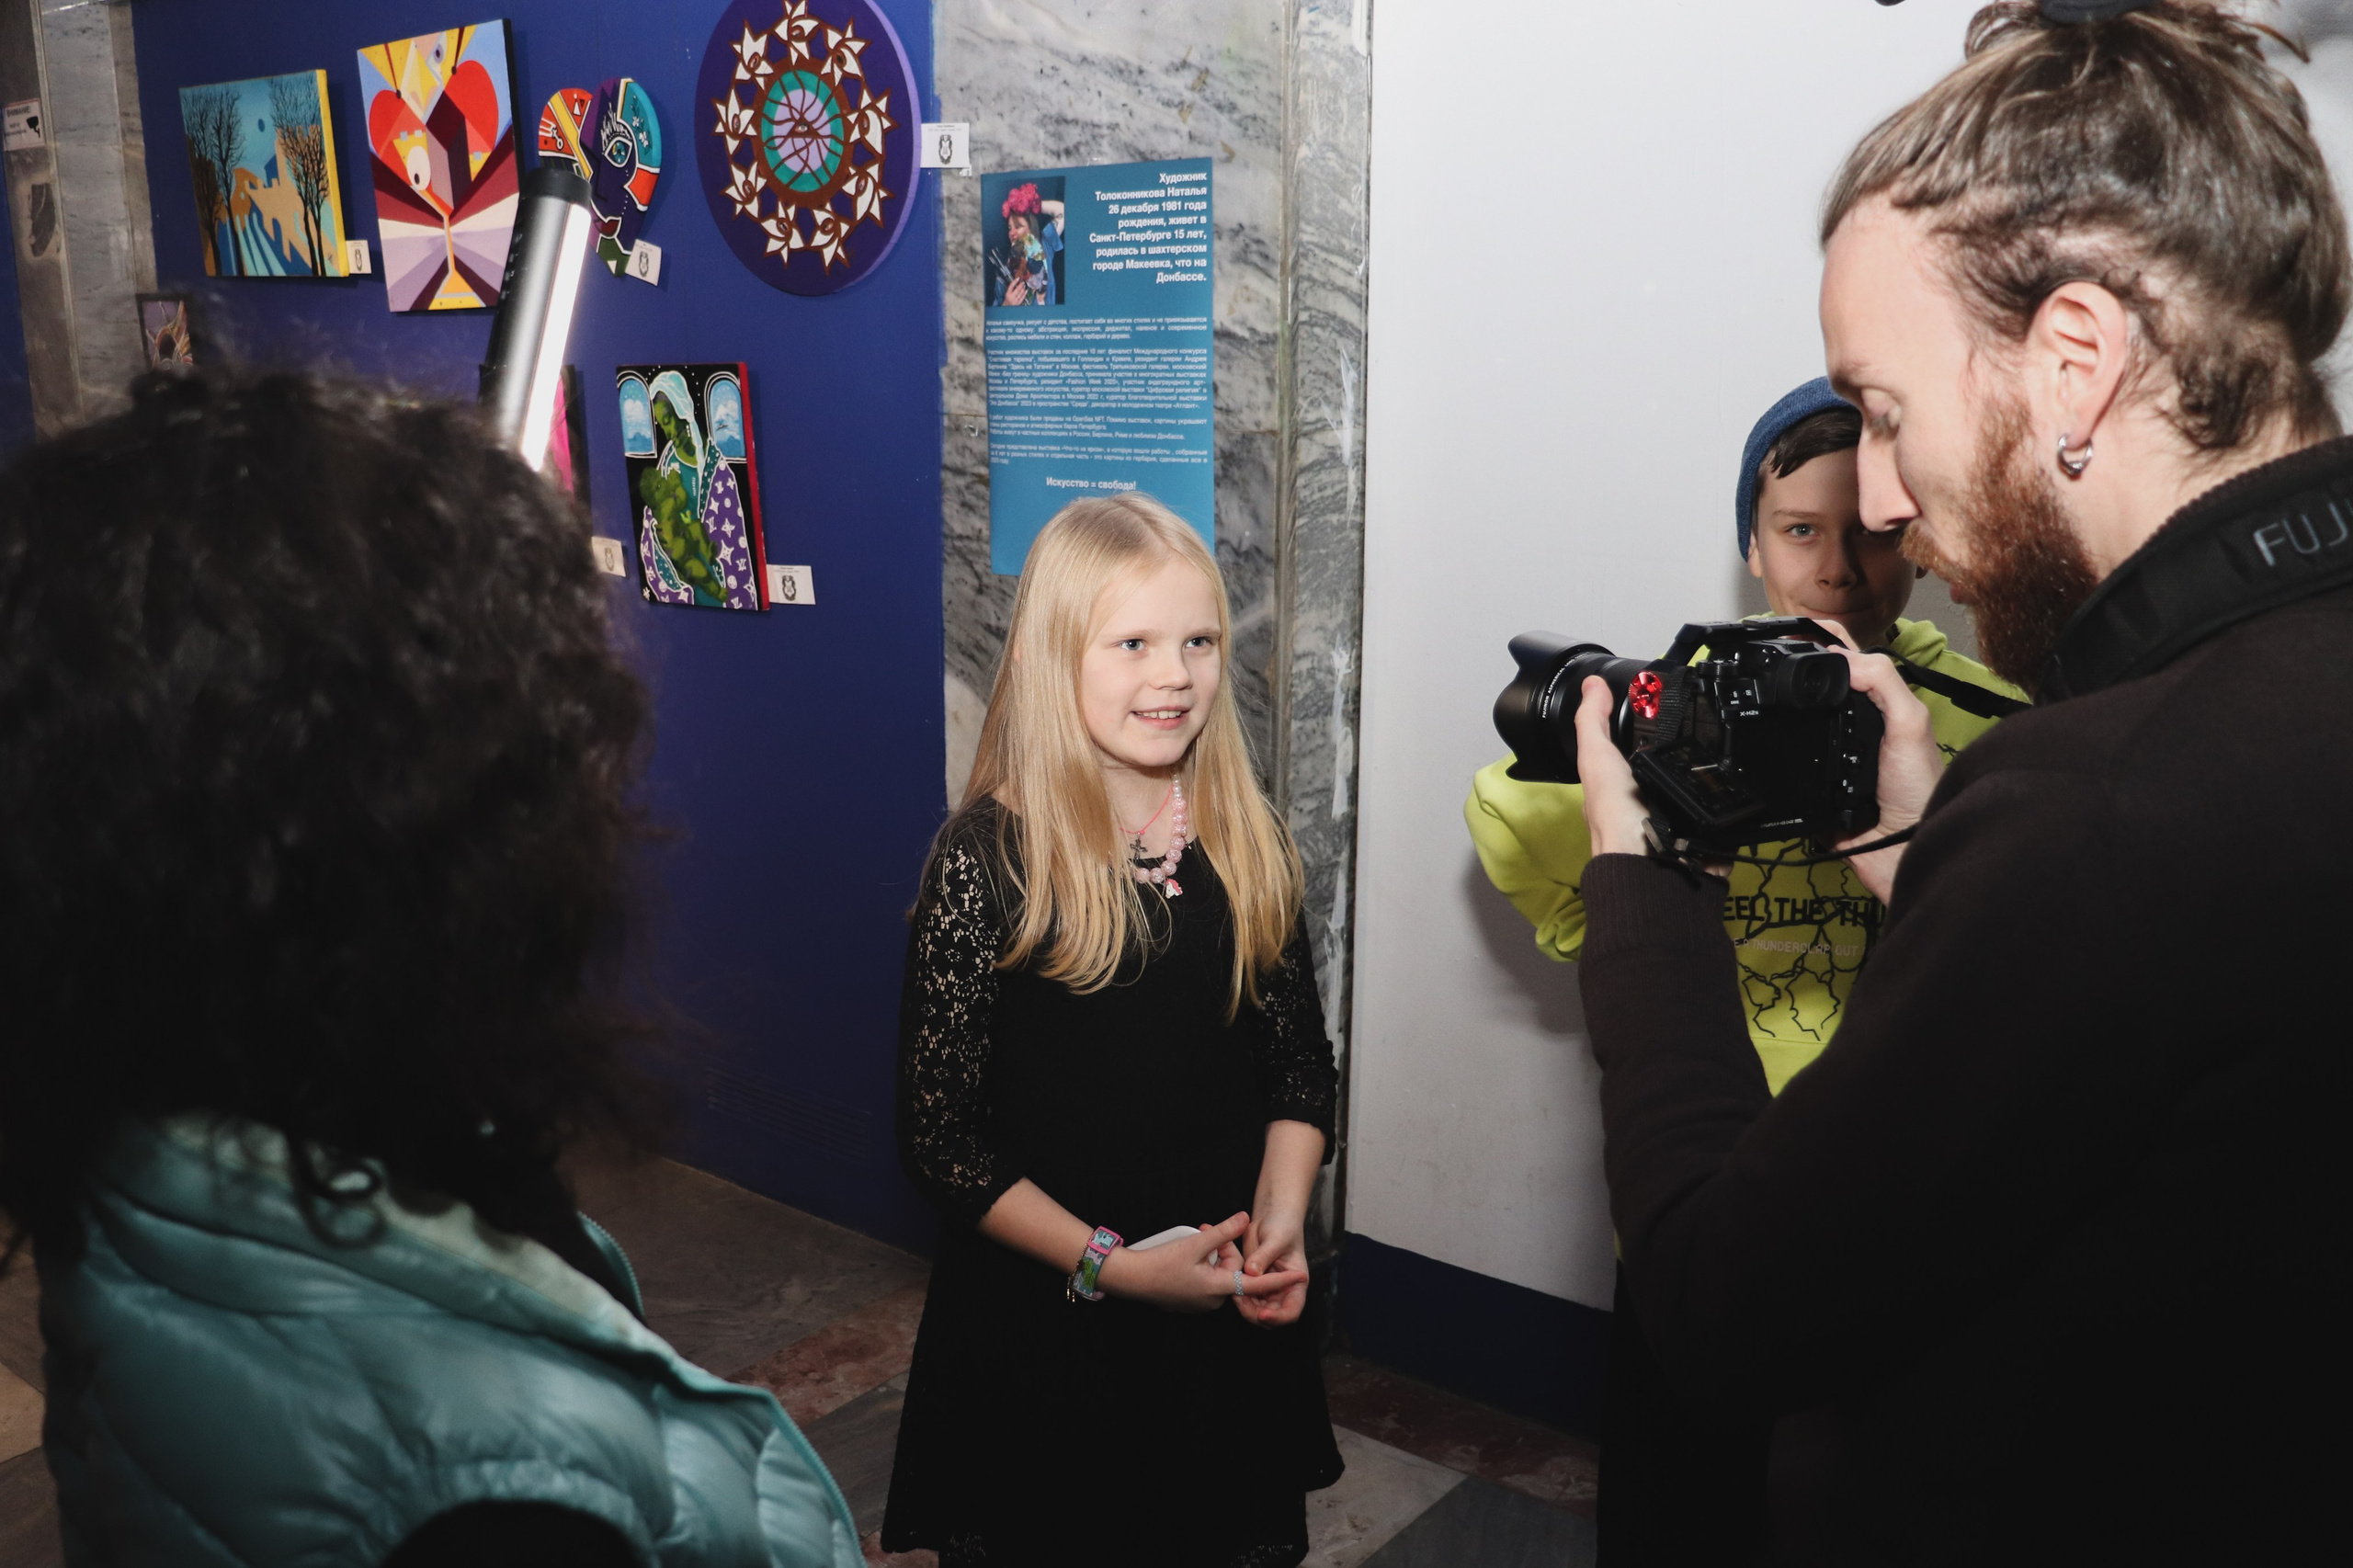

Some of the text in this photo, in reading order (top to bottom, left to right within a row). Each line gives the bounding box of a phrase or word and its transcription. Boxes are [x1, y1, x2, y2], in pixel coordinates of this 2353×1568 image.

[1159, 172, 1207, 185] Художник
[1095, 187, 1207, 201] Толоконникова Наталья
[1108, 201, 1207, 215] 26 декабря 1981 года
[1118, 216, 1207, 230] рождения, живет в
[1089, 230, 1207, 244] Санкт-Петербурге 15 лет,
[1096, 248, 1139, 258] родилась
[1148, 245, 1207, 256] шахтерском
[1092, 262, 1123, 272] городе
[1126, 259, 1173, 270] Макеевка,
[1156, 271, 1207, 284] Донбассе.
[1046, 477, 1089, 489] Искусство
[1098, 479, 1137, 491] свобода!
[1775, 897, 1824, 924] THE
[1753, 940, 1831, 955] THUNDERCLAP
